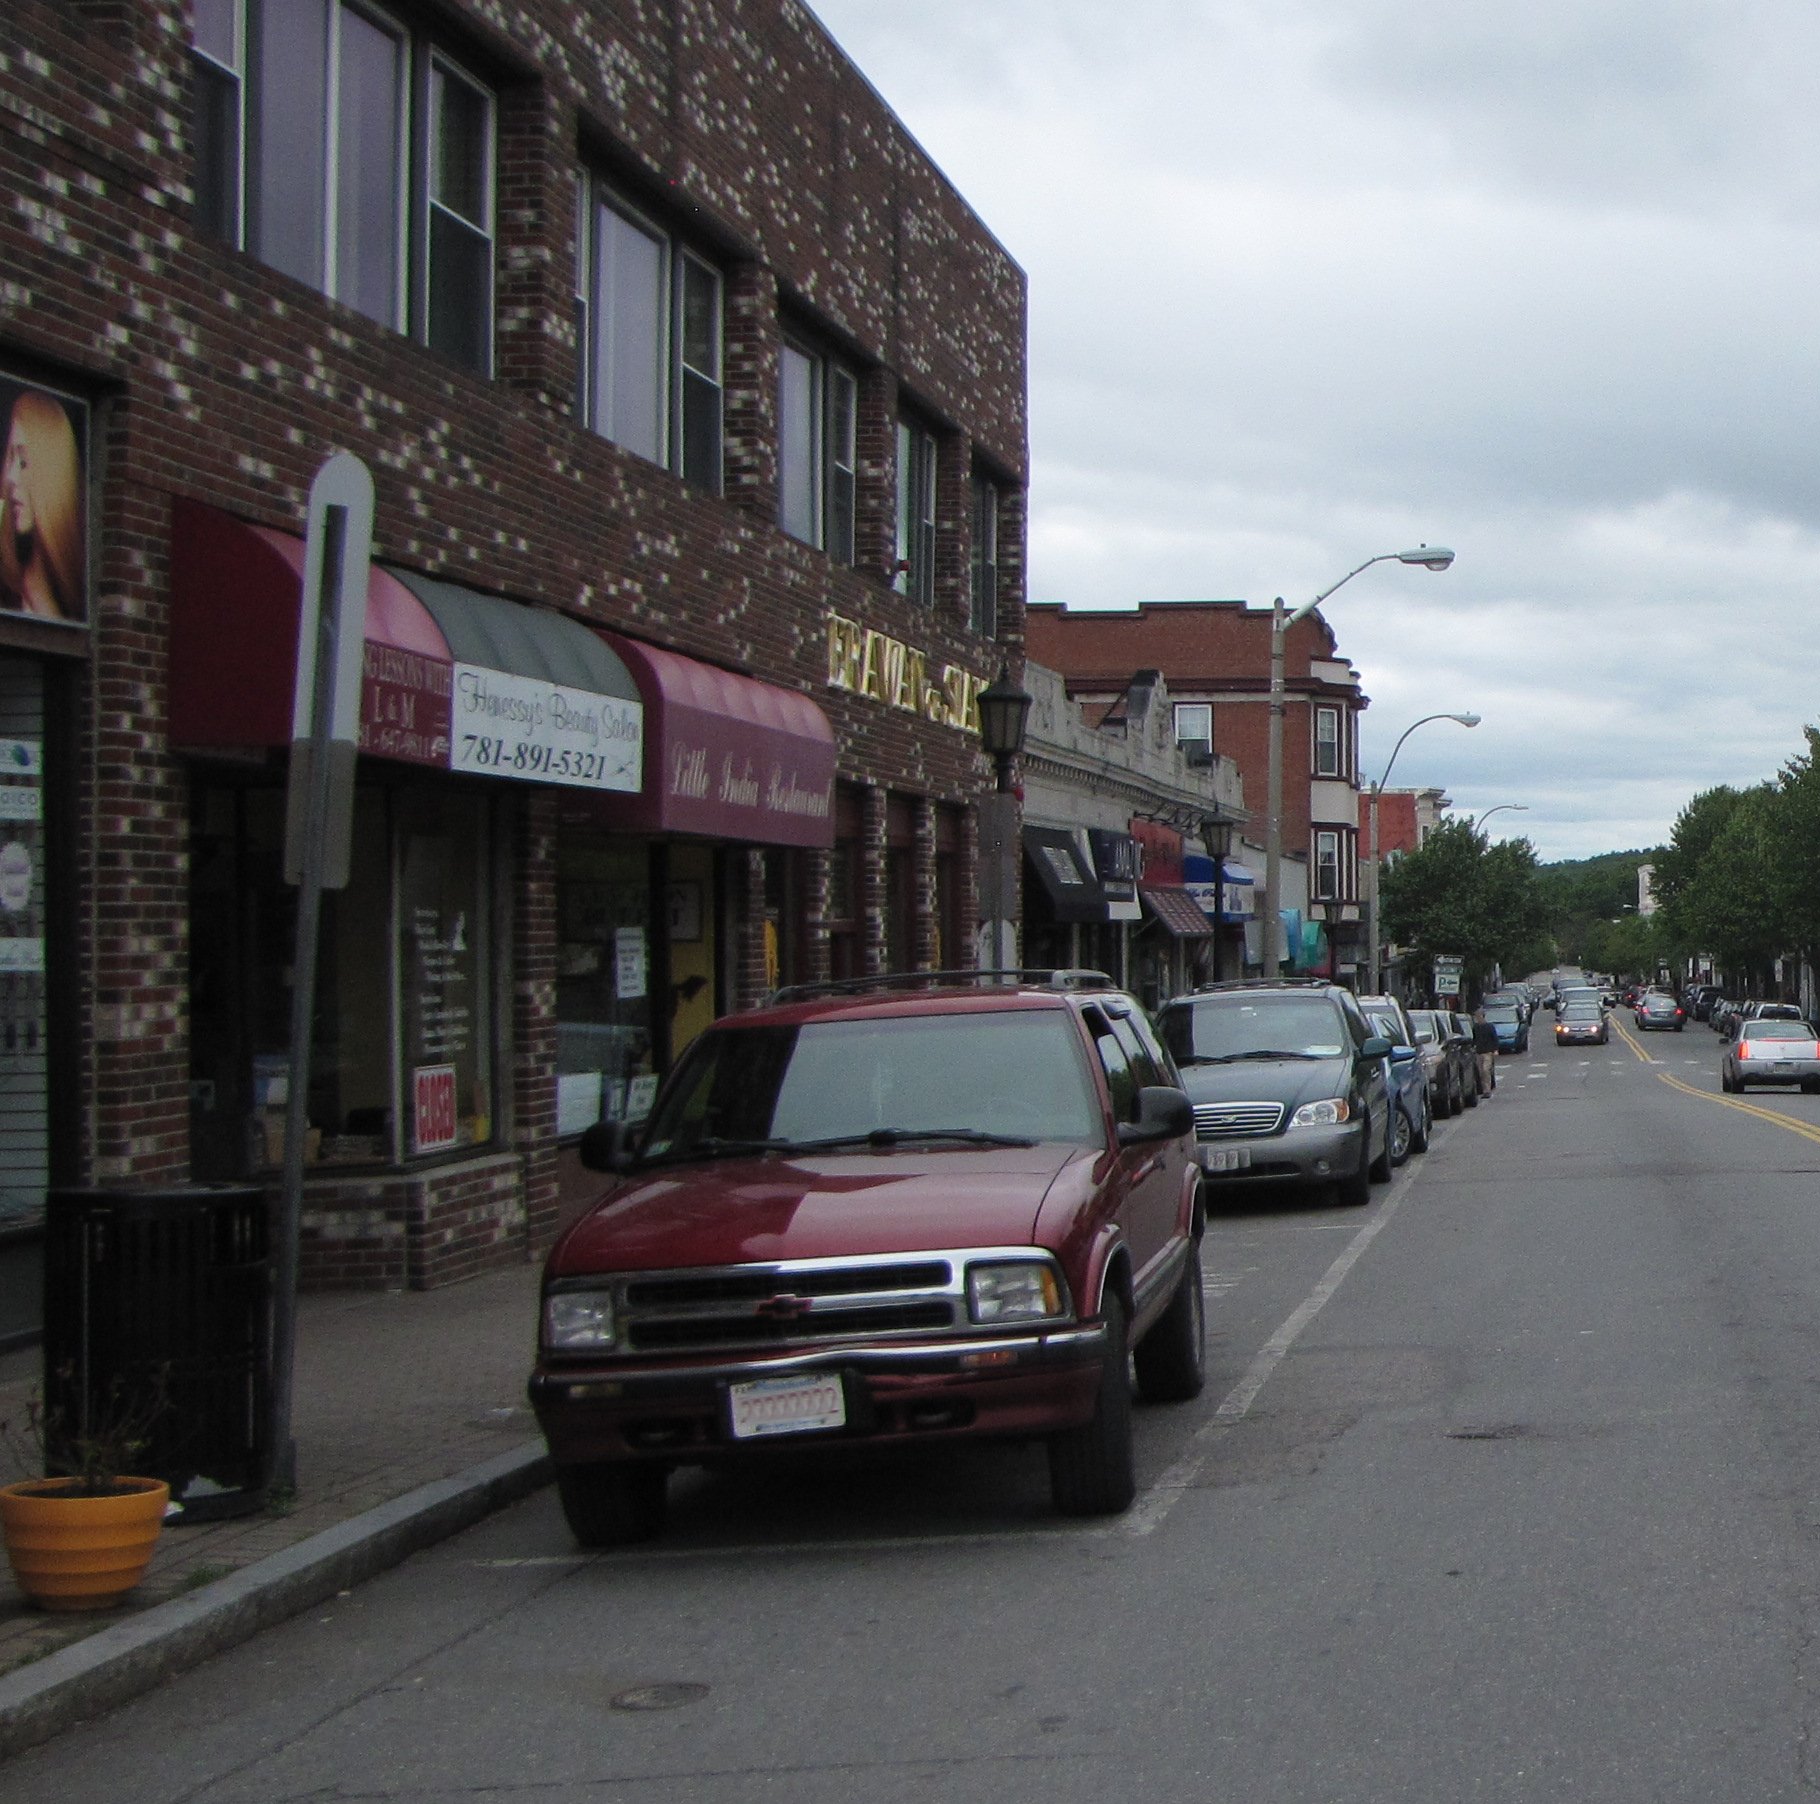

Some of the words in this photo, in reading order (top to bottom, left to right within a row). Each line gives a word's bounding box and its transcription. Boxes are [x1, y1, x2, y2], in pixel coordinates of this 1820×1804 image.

[550, 693, 599, 748] Beauty
[602, 704, 640, 743] Salon
[942, 664, 990, 736] SIA
[462, 734, 607, 781] 781-891-5321
[671, 740, 710, 799] Little
[718, 751, 760, 808] India
[766, 760, 833, 818] Restaurant
[1439, 976, 1447, 990] P
